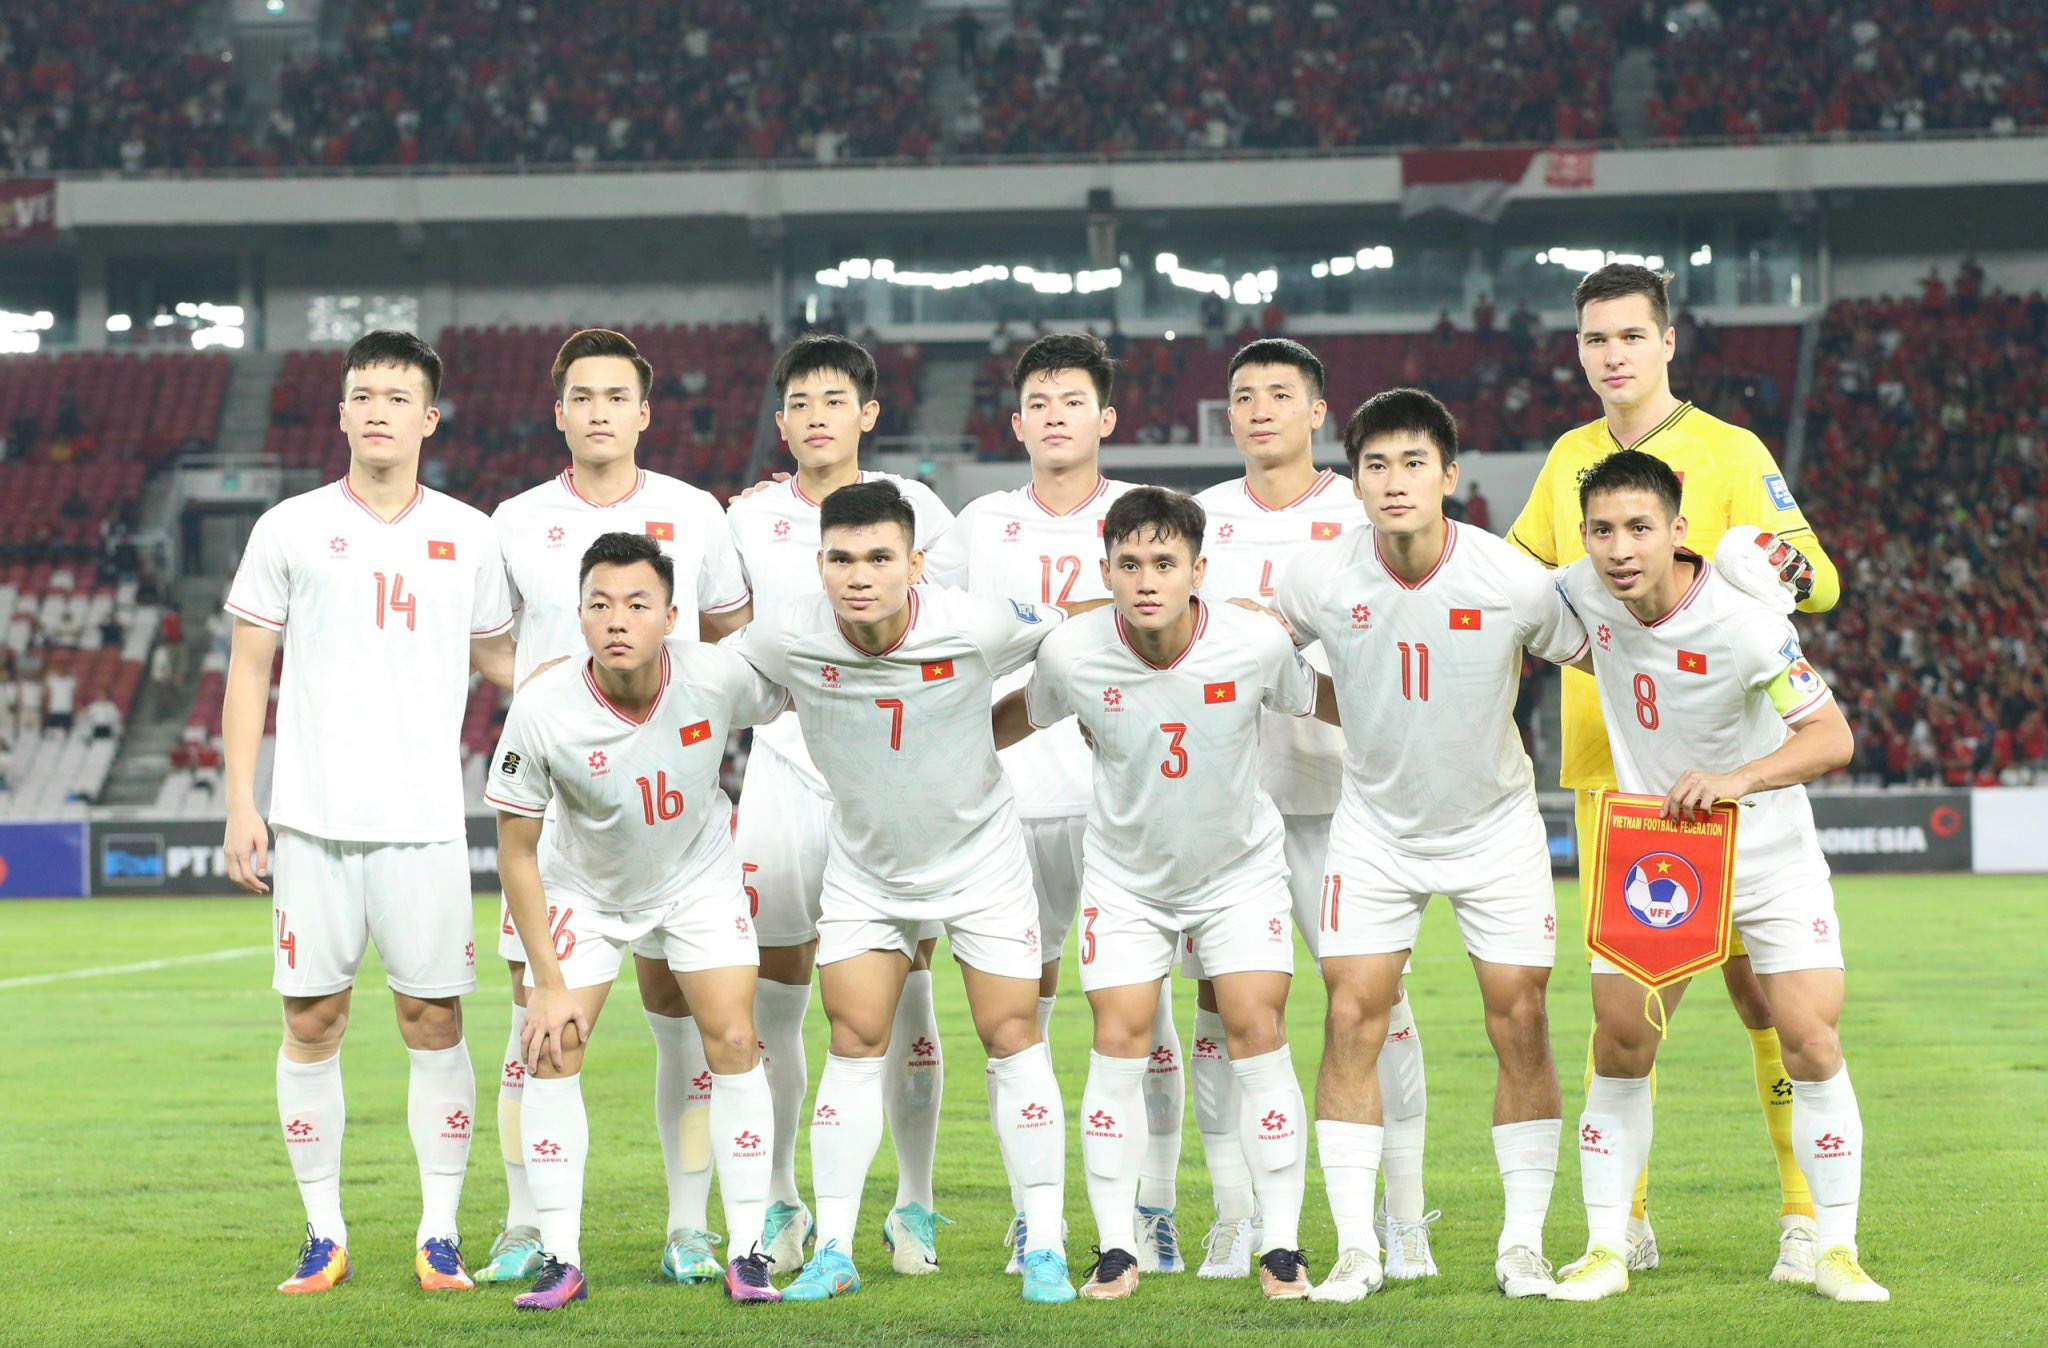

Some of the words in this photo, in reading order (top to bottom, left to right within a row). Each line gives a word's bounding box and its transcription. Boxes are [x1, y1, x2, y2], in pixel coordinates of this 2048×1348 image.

[373, 571, 416, 632] 14
[1039, 555, 1081, 605] 12
[1397, 641, 1429, 702] 11
[875, 698, 904, 751] 7
[1633, 672, 1660, 731] 8
[1160, 723, 1188, 779] 3
[636, 770, 684, 826] 16
[1612, 815, 1642, 830] VIETNAM
[1643, 818, 1678, 833] FOOTBALL
[1680, 821, 1723, 836] FEDERATION
[1320, 874, 1341, 932] 11
[1649, 908, 1673, 918] VFF
[1081, 907, 1099, 965] 3
